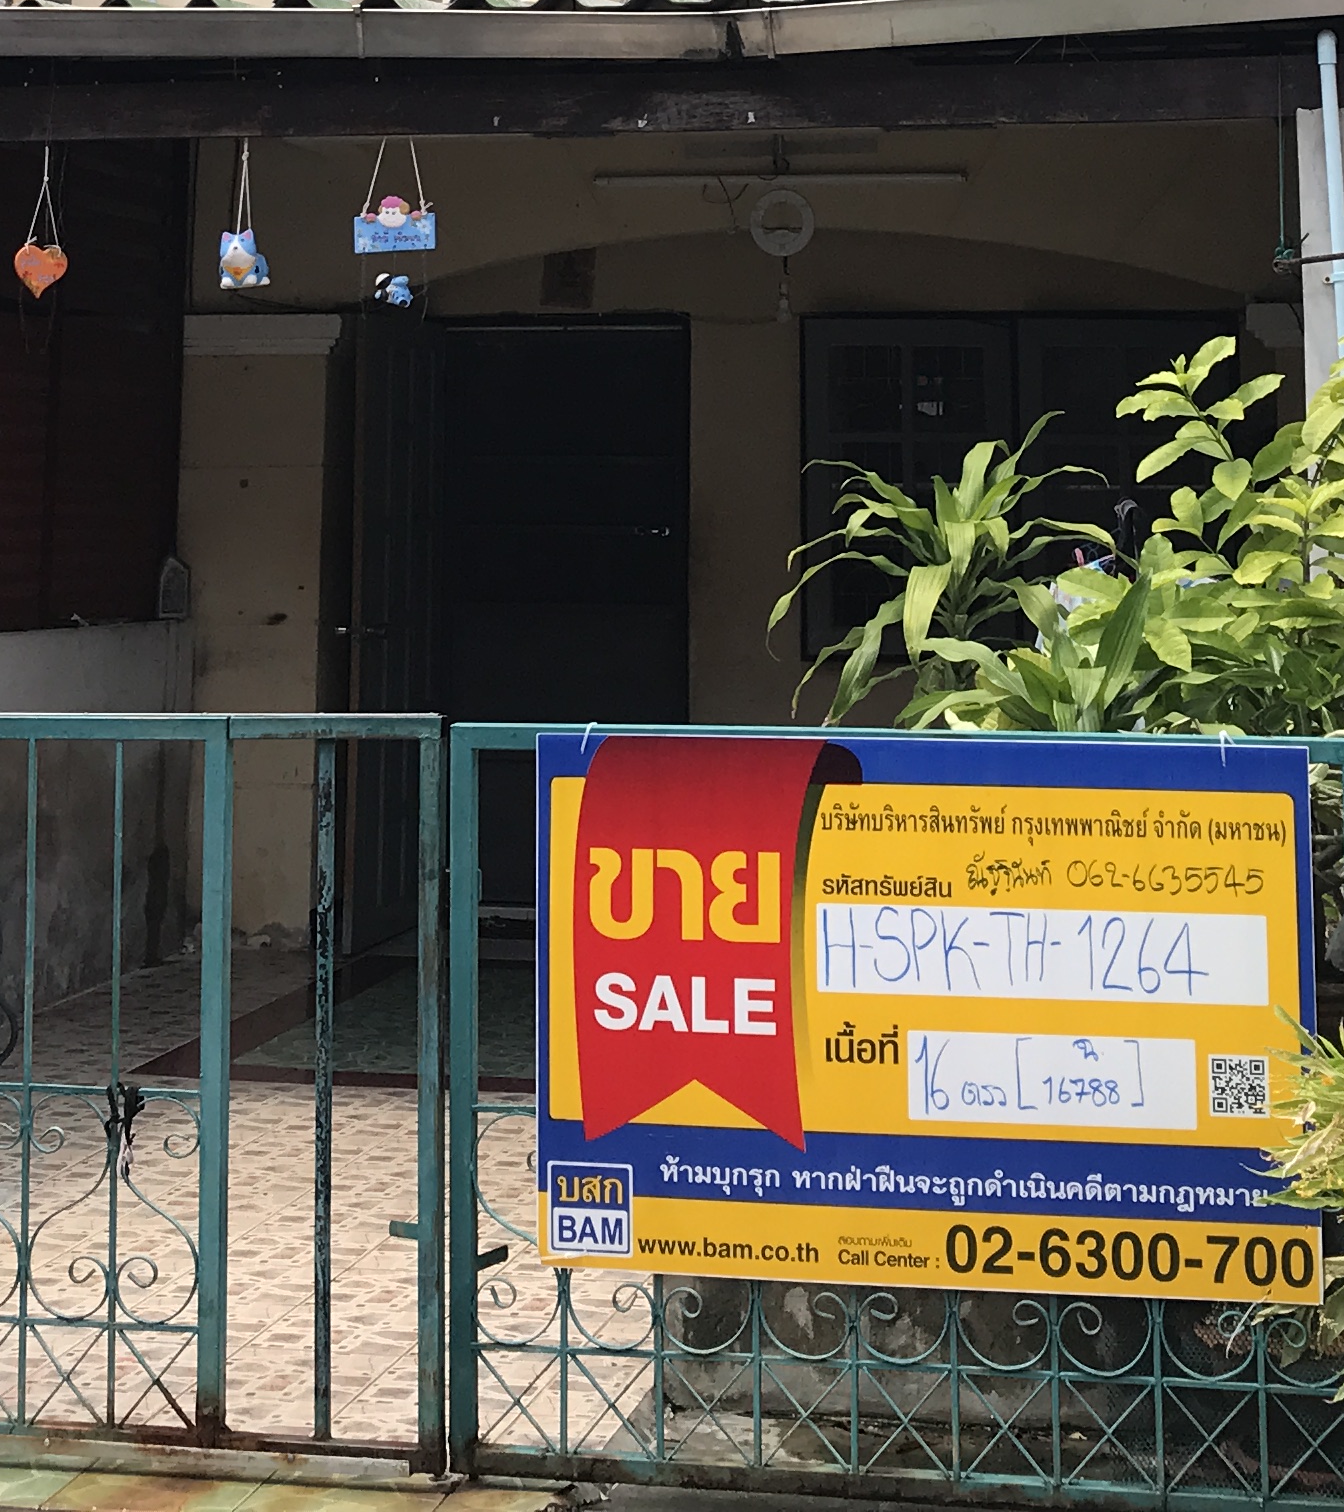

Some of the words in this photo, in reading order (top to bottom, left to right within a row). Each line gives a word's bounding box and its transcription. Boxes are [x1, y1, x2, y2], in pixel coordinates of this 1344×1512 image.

[821, 802, 1007, 835] บริษัทบริหารสินทรัพย์
[1012, 807, 1150, 846] กรุงเทพพาณิชย์
[1153, 809, 1202, 839] จำกัด
[1208, 818, 1286, 847] (มหาชน)
[589, 847, 781, 944] ขาย
[822, 873, 953, 898] รหัสทรัพย์สิน
[1066, 859, 1265, 897] 062-6635545
[594, 972, 777, 1035] SALE
[825, 1021, 899, 1065] เนื้อที่
[914, 1035, 951, 1115] 16
[557, 1175, 623, 1204] บสก
[659, 1154, 781, 1197] ห้ามบุกรุก
[558, 1214, 623, 1246] BAM
[637, 1237, 819, 1264] www.bam.co.th
[837, 1249, 869, 1266] Call
[945, 1224, 1314, 1288] 02-6300-700
